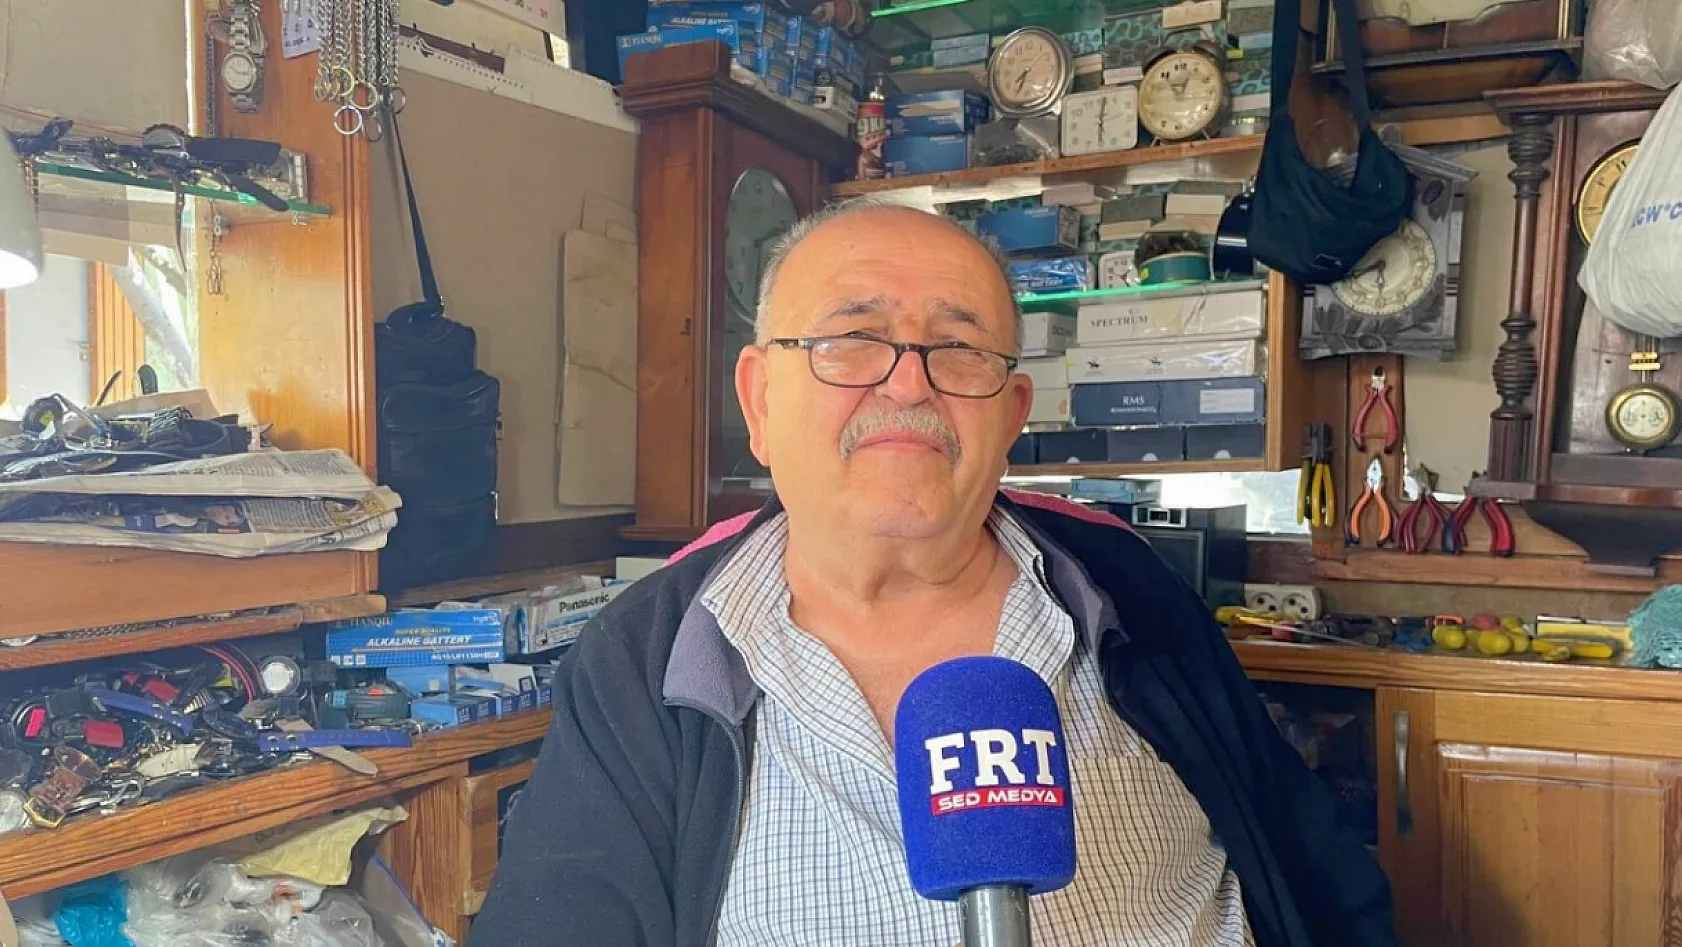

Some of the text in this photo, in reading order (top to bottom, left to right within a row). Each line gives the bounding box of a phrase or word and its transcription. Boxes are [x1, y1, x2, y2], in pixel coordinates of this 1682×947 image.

[1090, 315, 1149, 328] SPECTRUM
[1122, 395, 1146, 406] RMS
[559, 592, 610, 614] Panasonic
[366, 634, 472, 647] ALKALINE BATTERY
[924, 729, 1057, 795] FRT
[938, 789, 1058, 812] SED MEDYA
